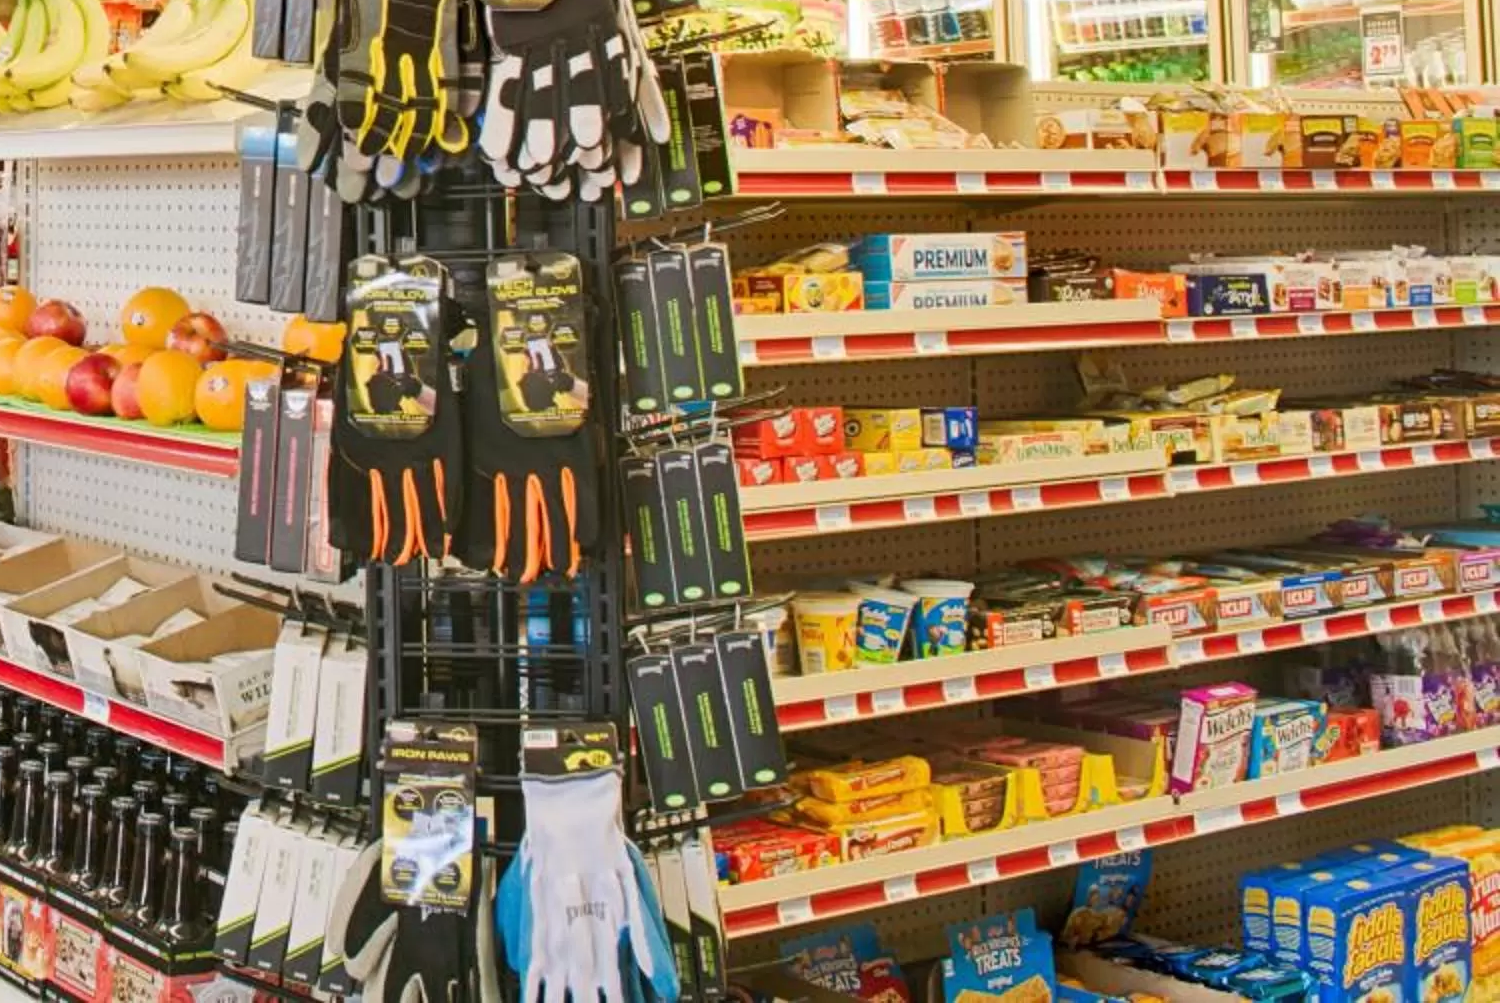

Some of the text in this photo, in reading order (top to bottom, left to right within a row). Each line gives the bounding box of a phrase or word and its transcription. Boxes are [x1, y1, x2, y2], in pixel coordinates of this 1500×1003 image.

[913, 249, 987, 269] PREMIUM
[241, 683, 270, 703] WIL
[975, 948, 1022, 976] TREATS
